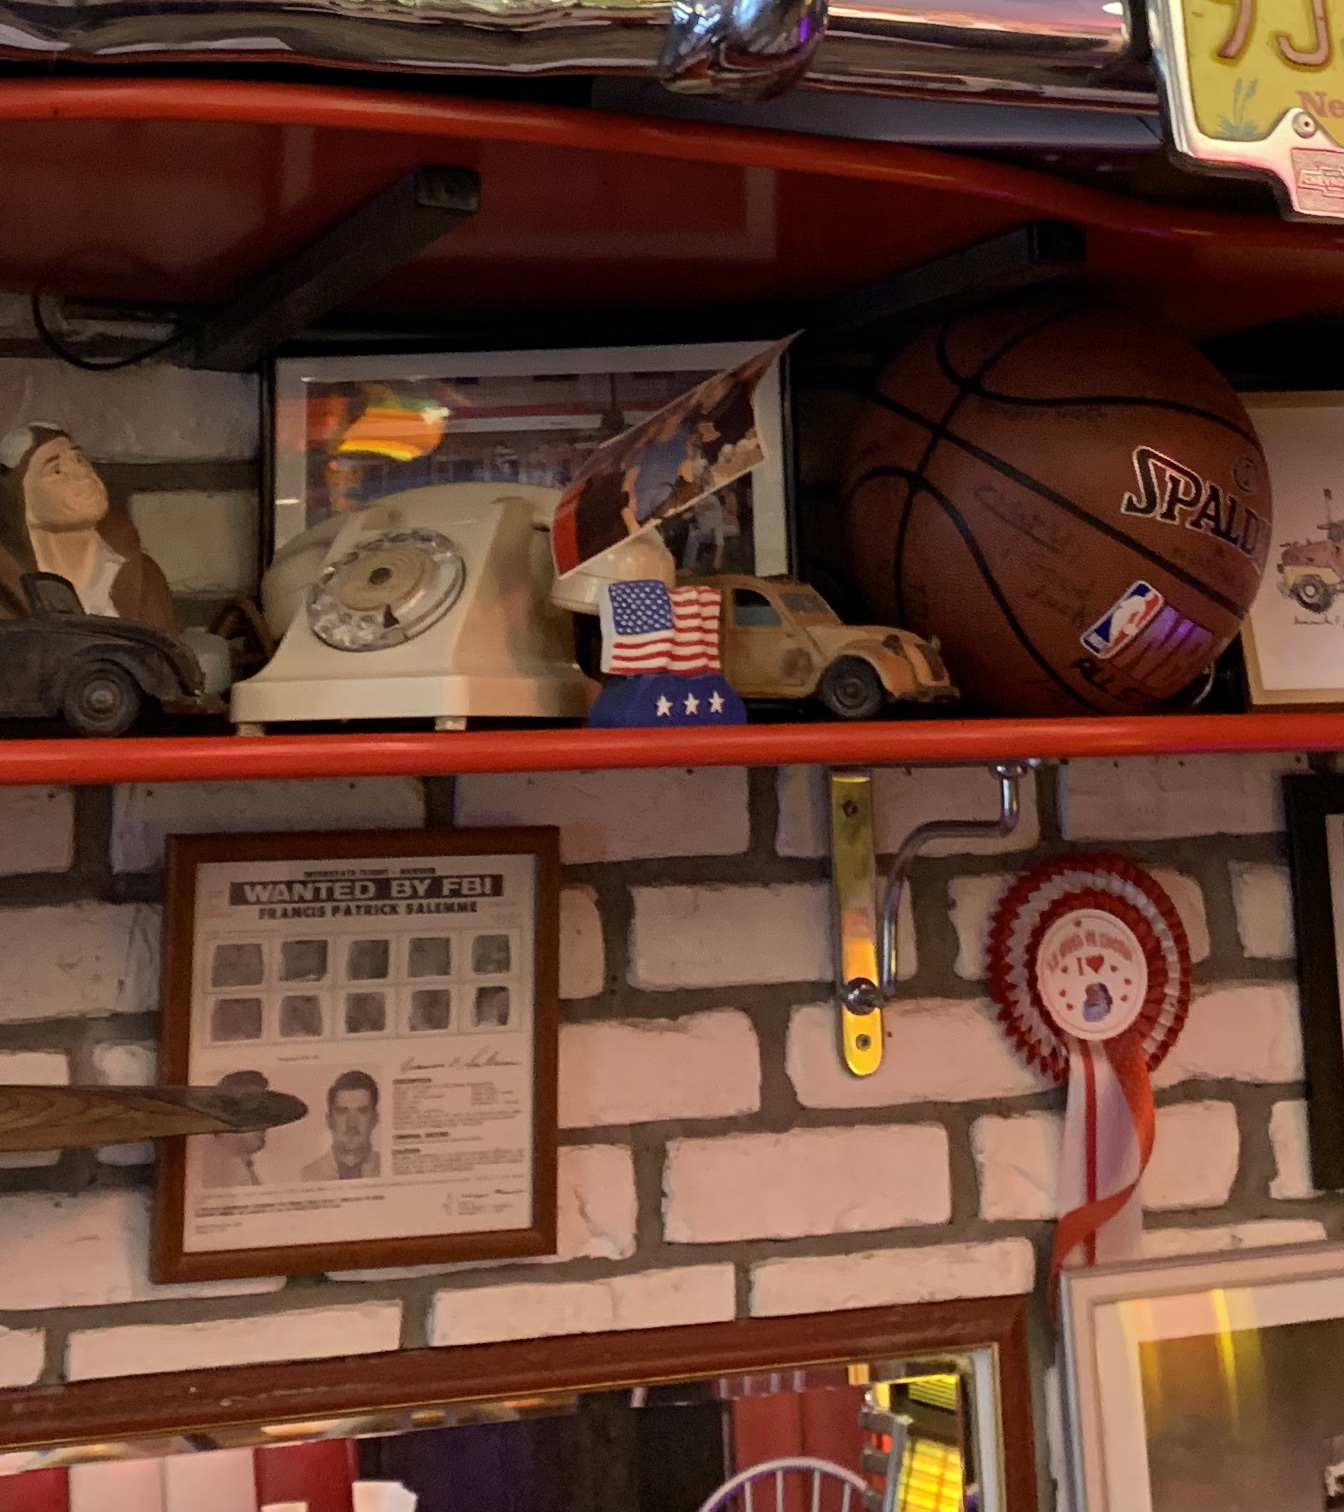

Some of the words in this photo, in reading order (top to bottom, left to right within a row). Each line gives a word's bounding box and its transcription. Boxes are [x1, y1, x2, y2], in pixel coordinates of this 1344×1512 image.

[243, 881, 376, 903] WANTED
[389, 879, 433, 899] BY
[258, 905, 325, 921] FRANCIS
[331, 902, 400, 918] PATRICK
